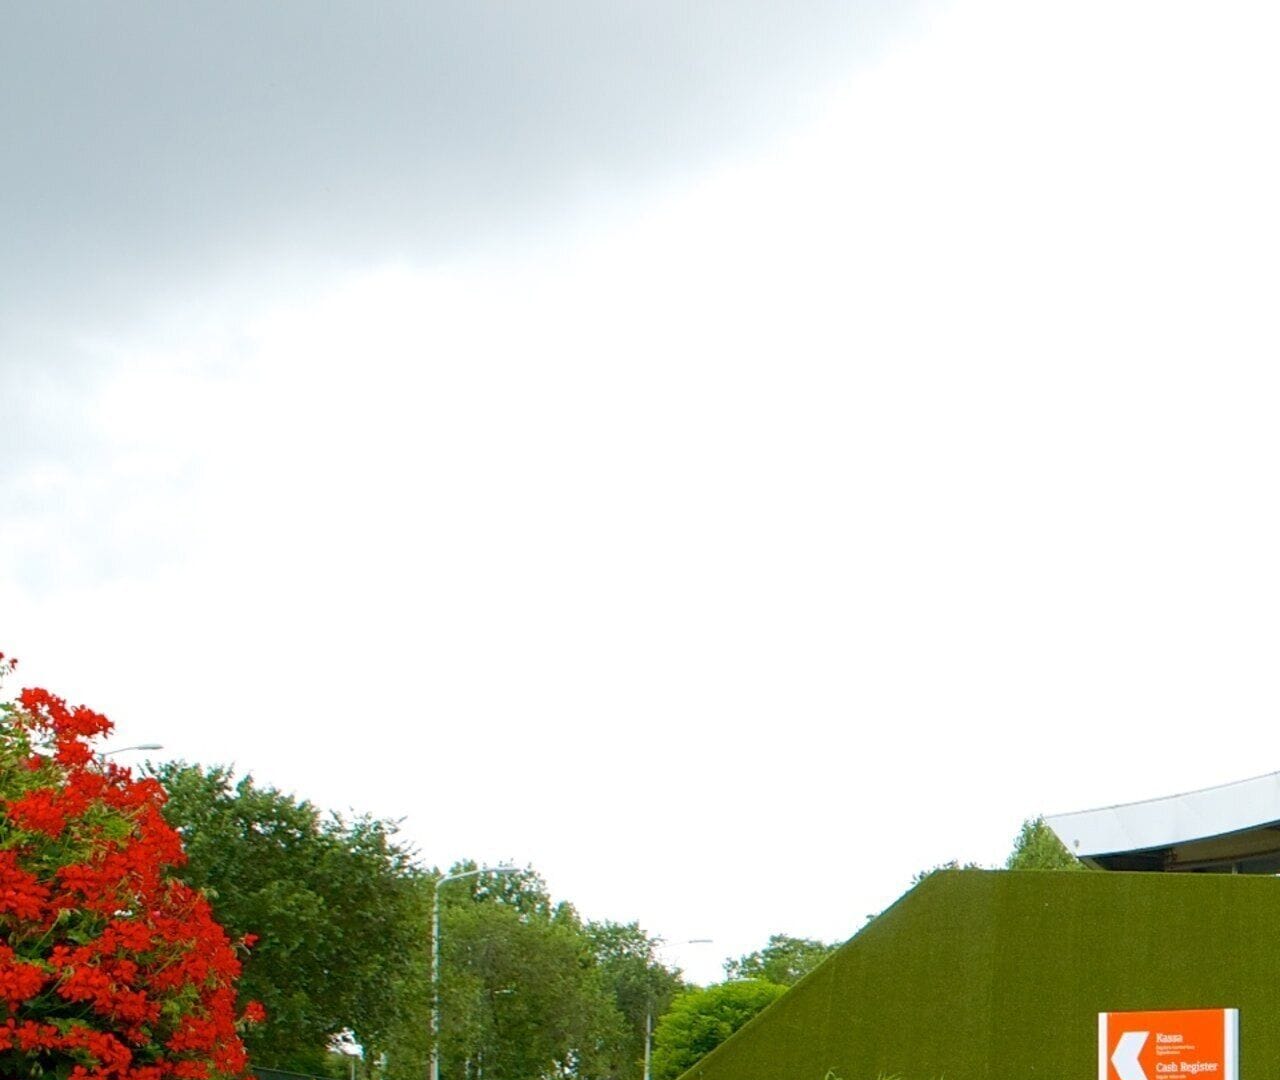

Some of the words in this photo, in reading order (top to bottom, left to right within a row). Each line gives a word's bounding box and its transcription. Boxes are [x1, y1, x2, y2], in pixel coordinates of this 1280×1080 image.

[1156, 1033, 1183, 1043] Kassa
[1156, 1062, 1178, 1072] Cash
[1180, 1061, 1218, 1074] Register
